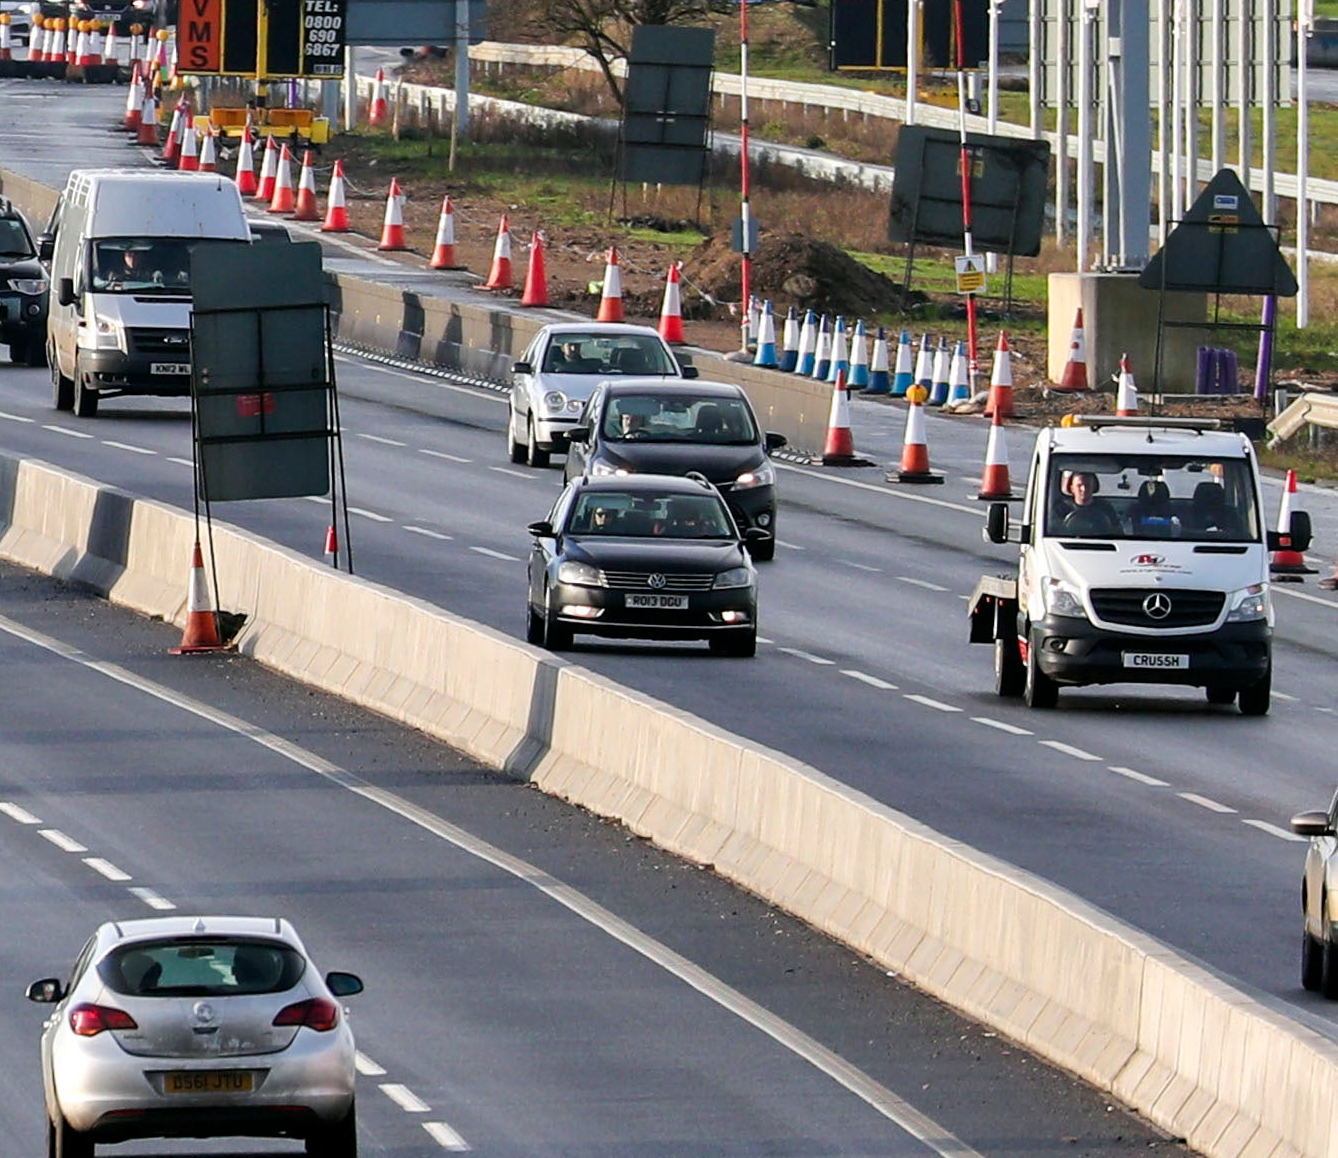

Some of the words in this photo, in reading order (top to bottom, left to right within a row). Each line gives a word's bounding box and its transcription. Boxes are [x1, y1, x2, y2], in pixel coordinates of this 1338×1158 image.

[306, 0, 339, 13] TEL:
[305, 16, 341, 30] 0800
[309, 30, 336, 43] 690
[1133, 655, 1180, 667] CRUSSH
